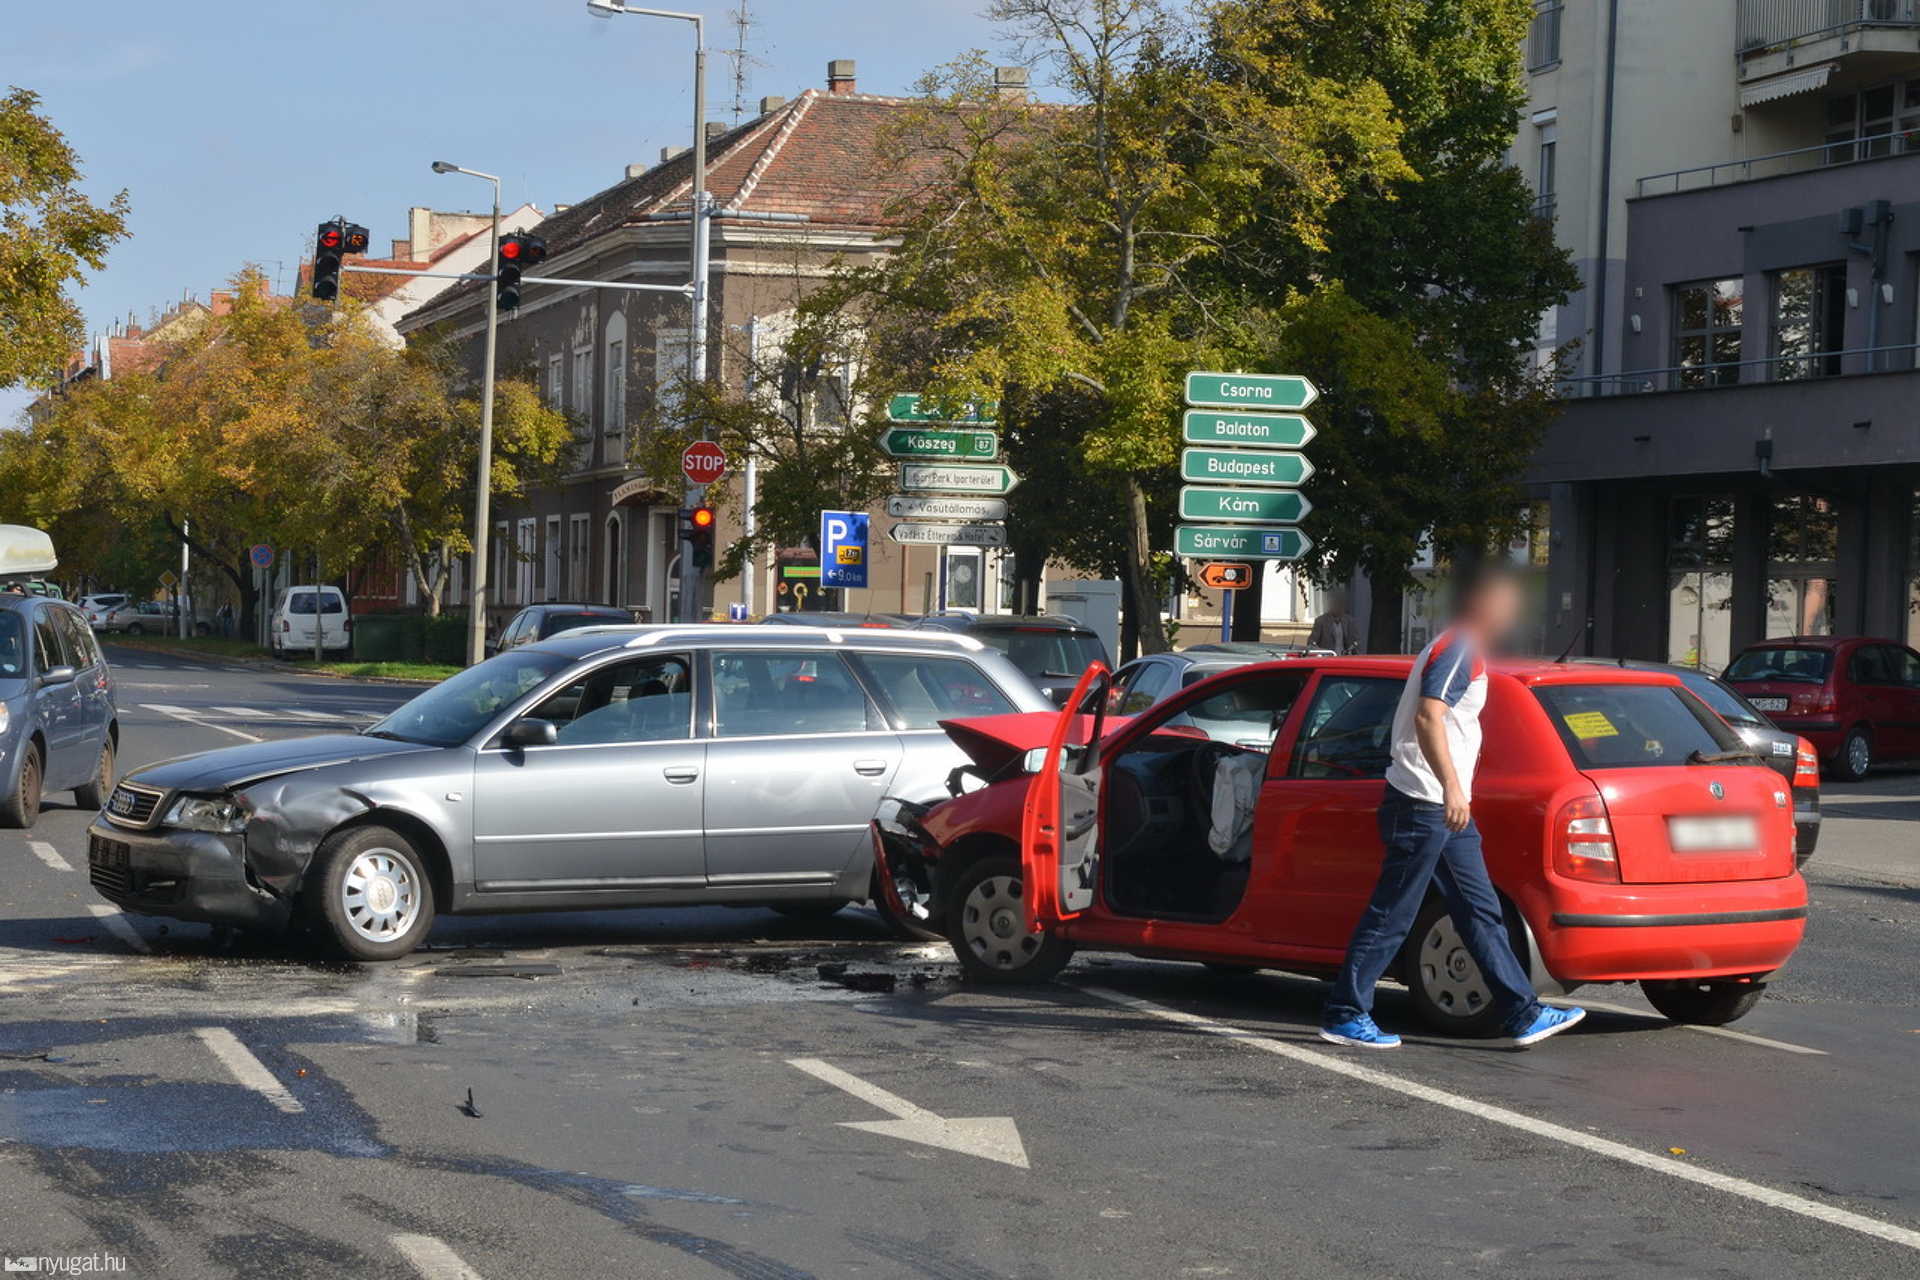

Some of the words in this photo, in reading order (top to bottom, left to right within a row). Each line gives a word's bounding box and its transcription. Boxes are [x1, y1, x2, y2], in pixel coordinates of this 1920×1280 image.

[1220, 382, 1272, 398] Csorna
[1215, 420, 1270, 437] Balaton
[685, 454, 724, 472] STOP
[1207, 458, 1276, 476] Budapest
[1219, 496, 1260, 512] Kám
[827, 519, 847, 554] P
[1193, 533, 1248, 549] Sárvár
